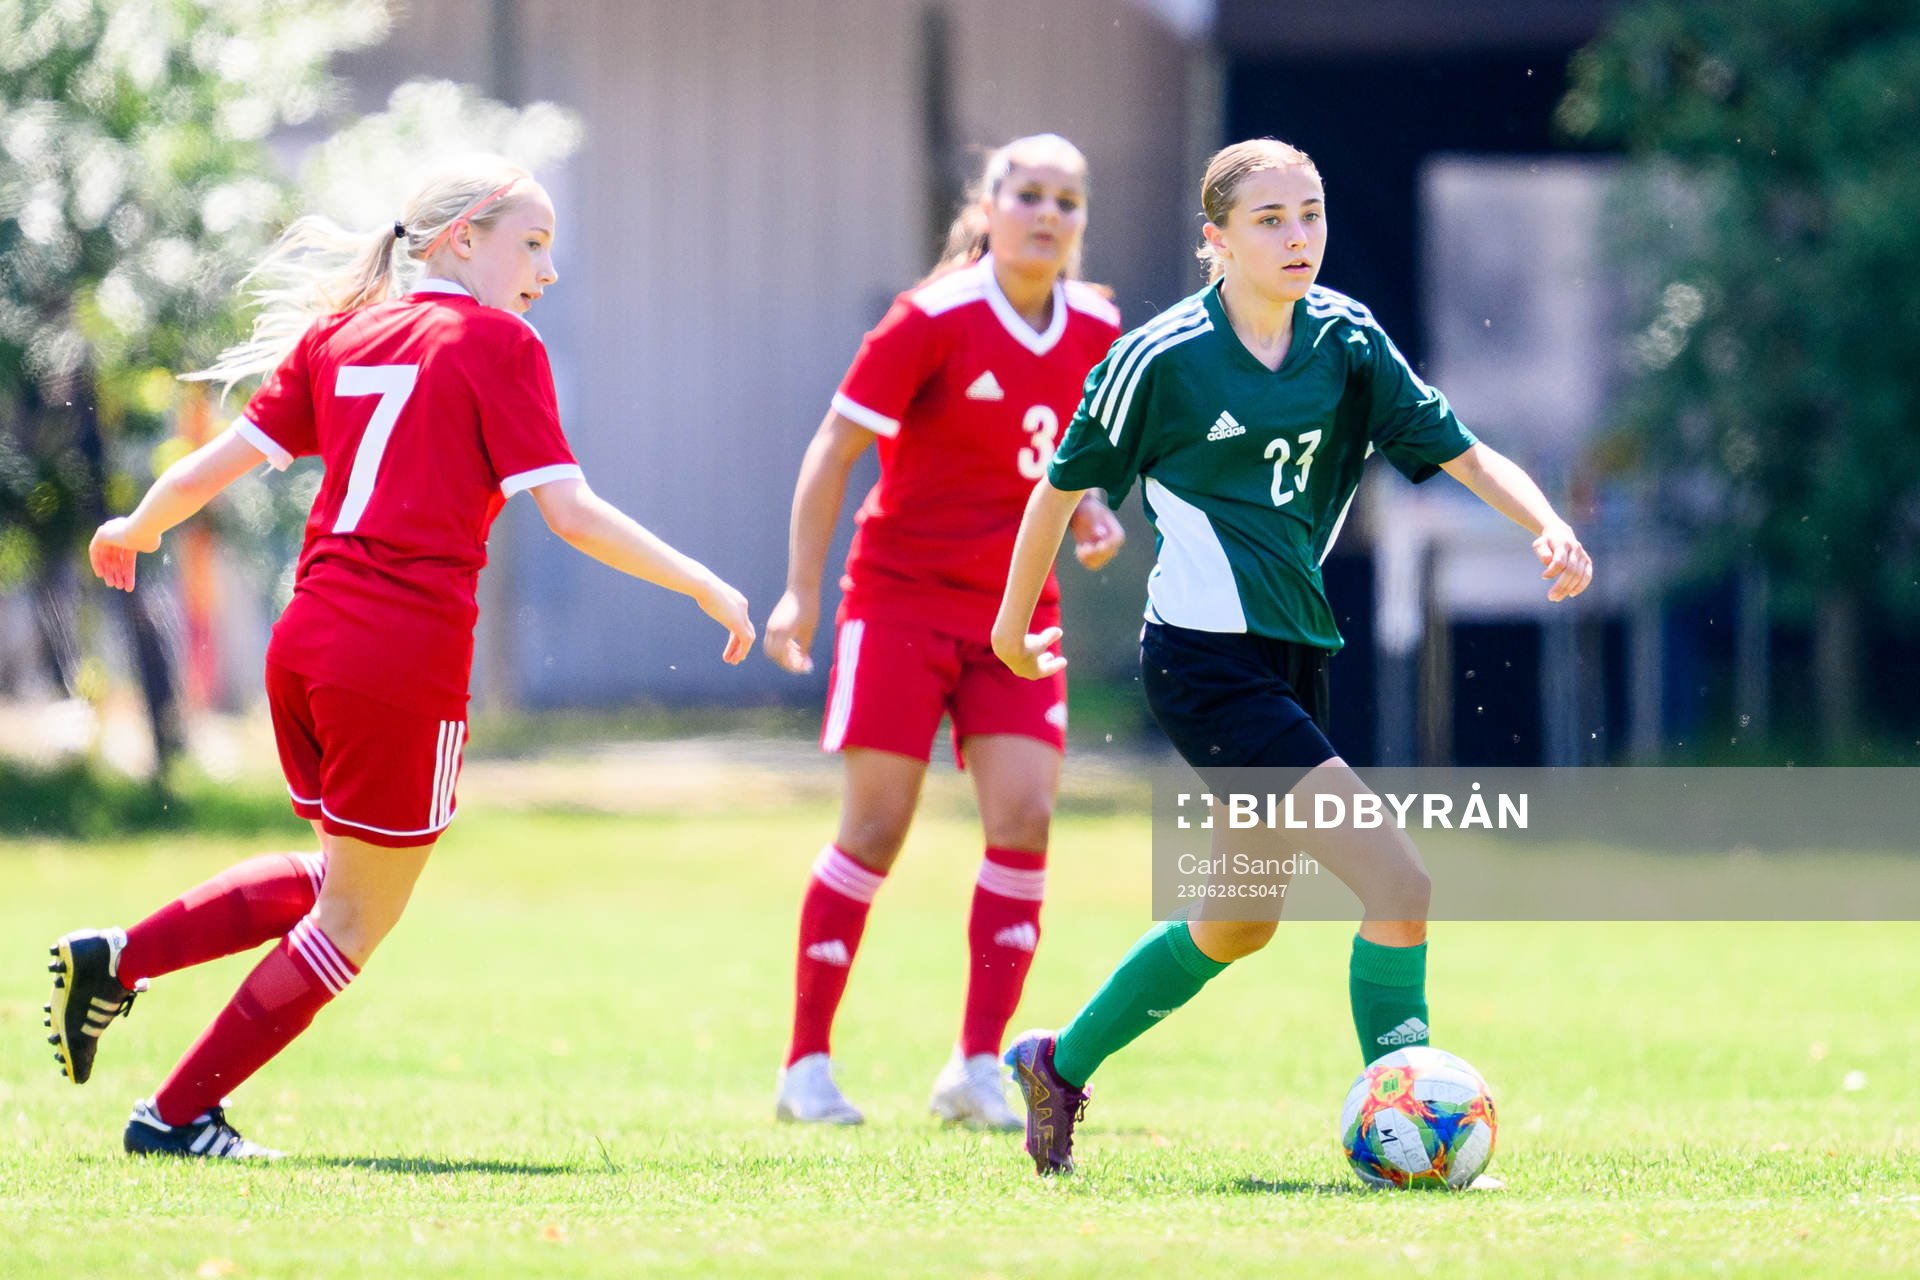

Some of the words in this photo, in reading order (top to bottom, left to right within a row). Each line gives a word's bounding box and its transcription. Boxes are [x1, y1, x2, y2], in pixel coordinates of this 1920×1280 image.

[332, 364, 420, 534] 7
[1017, 404, 1059, 479] 3
[1207, 425, 1246, 442] adidas
[1264, 429, 1322, 507] 23
